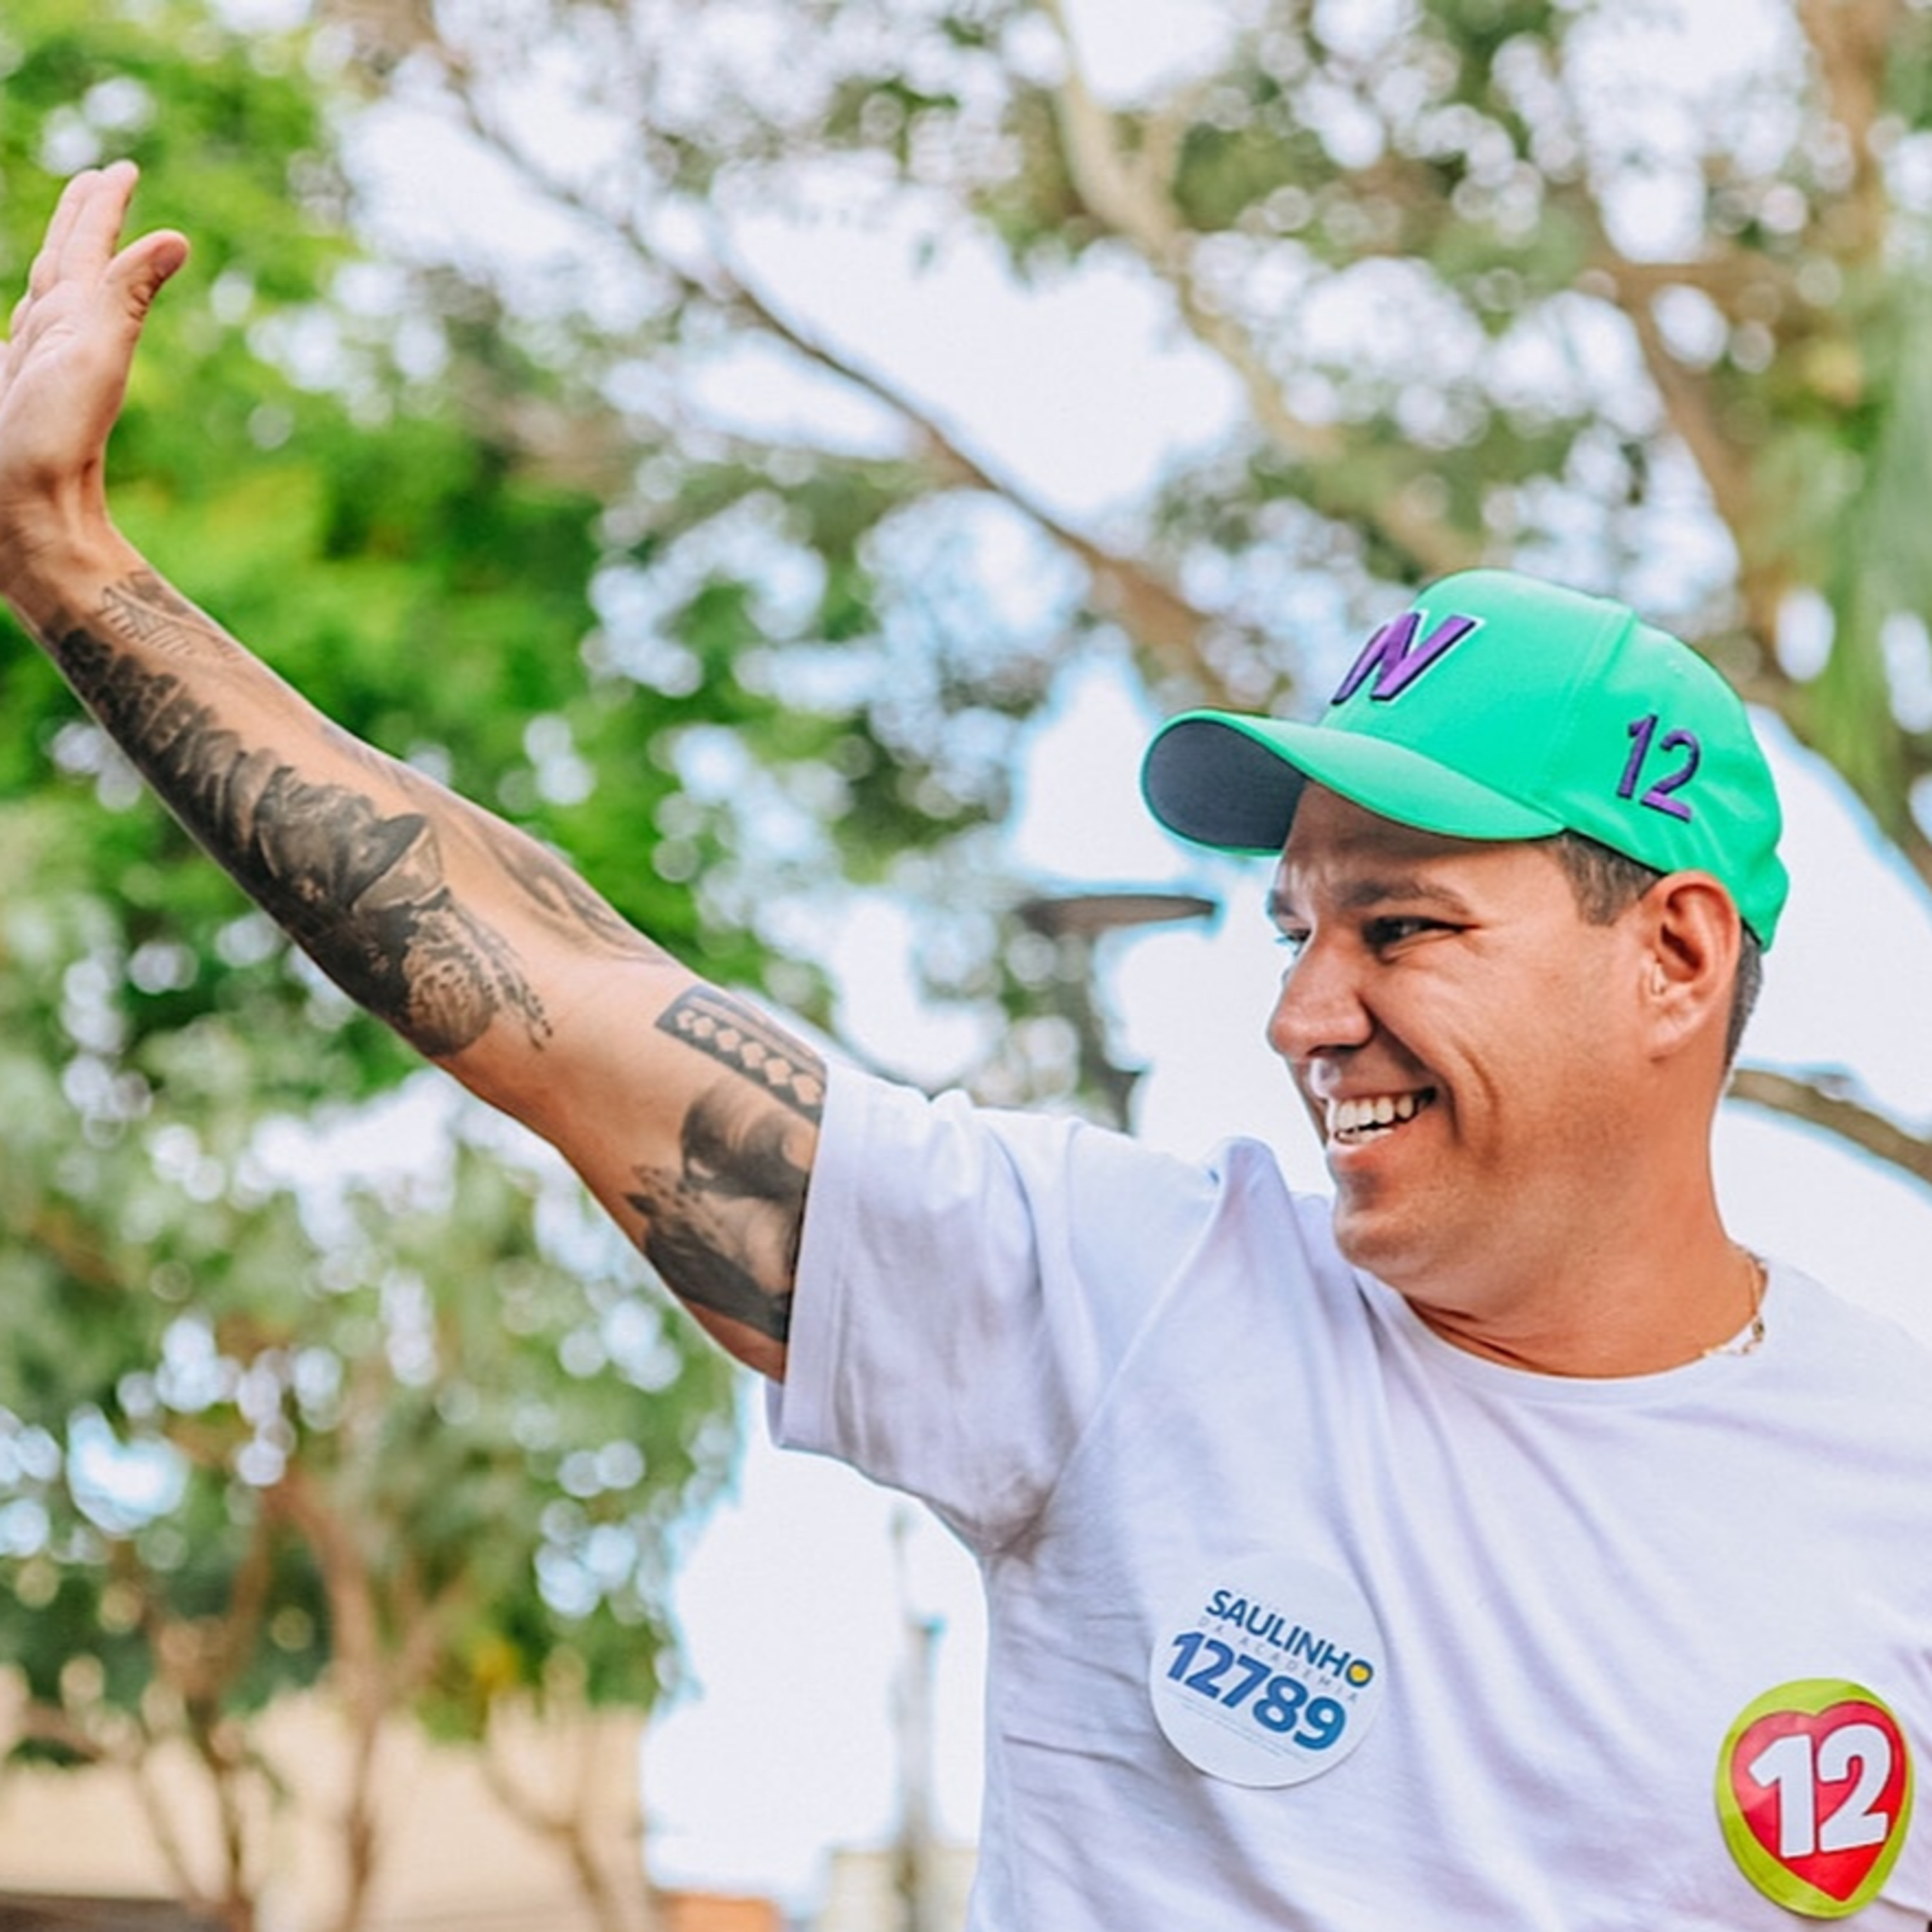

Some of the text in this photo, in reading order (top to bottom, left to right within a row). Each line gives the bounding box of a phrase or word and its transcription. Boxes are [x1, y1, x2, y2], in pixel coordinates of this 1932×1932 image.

[1616, 714, 1701, 823] 12
[1167, 1631, 1346, 1751] 12789
[1206, 1589, 1374, 1688] SAULINHO
[1748, 1723, 1892, 1859] 12
